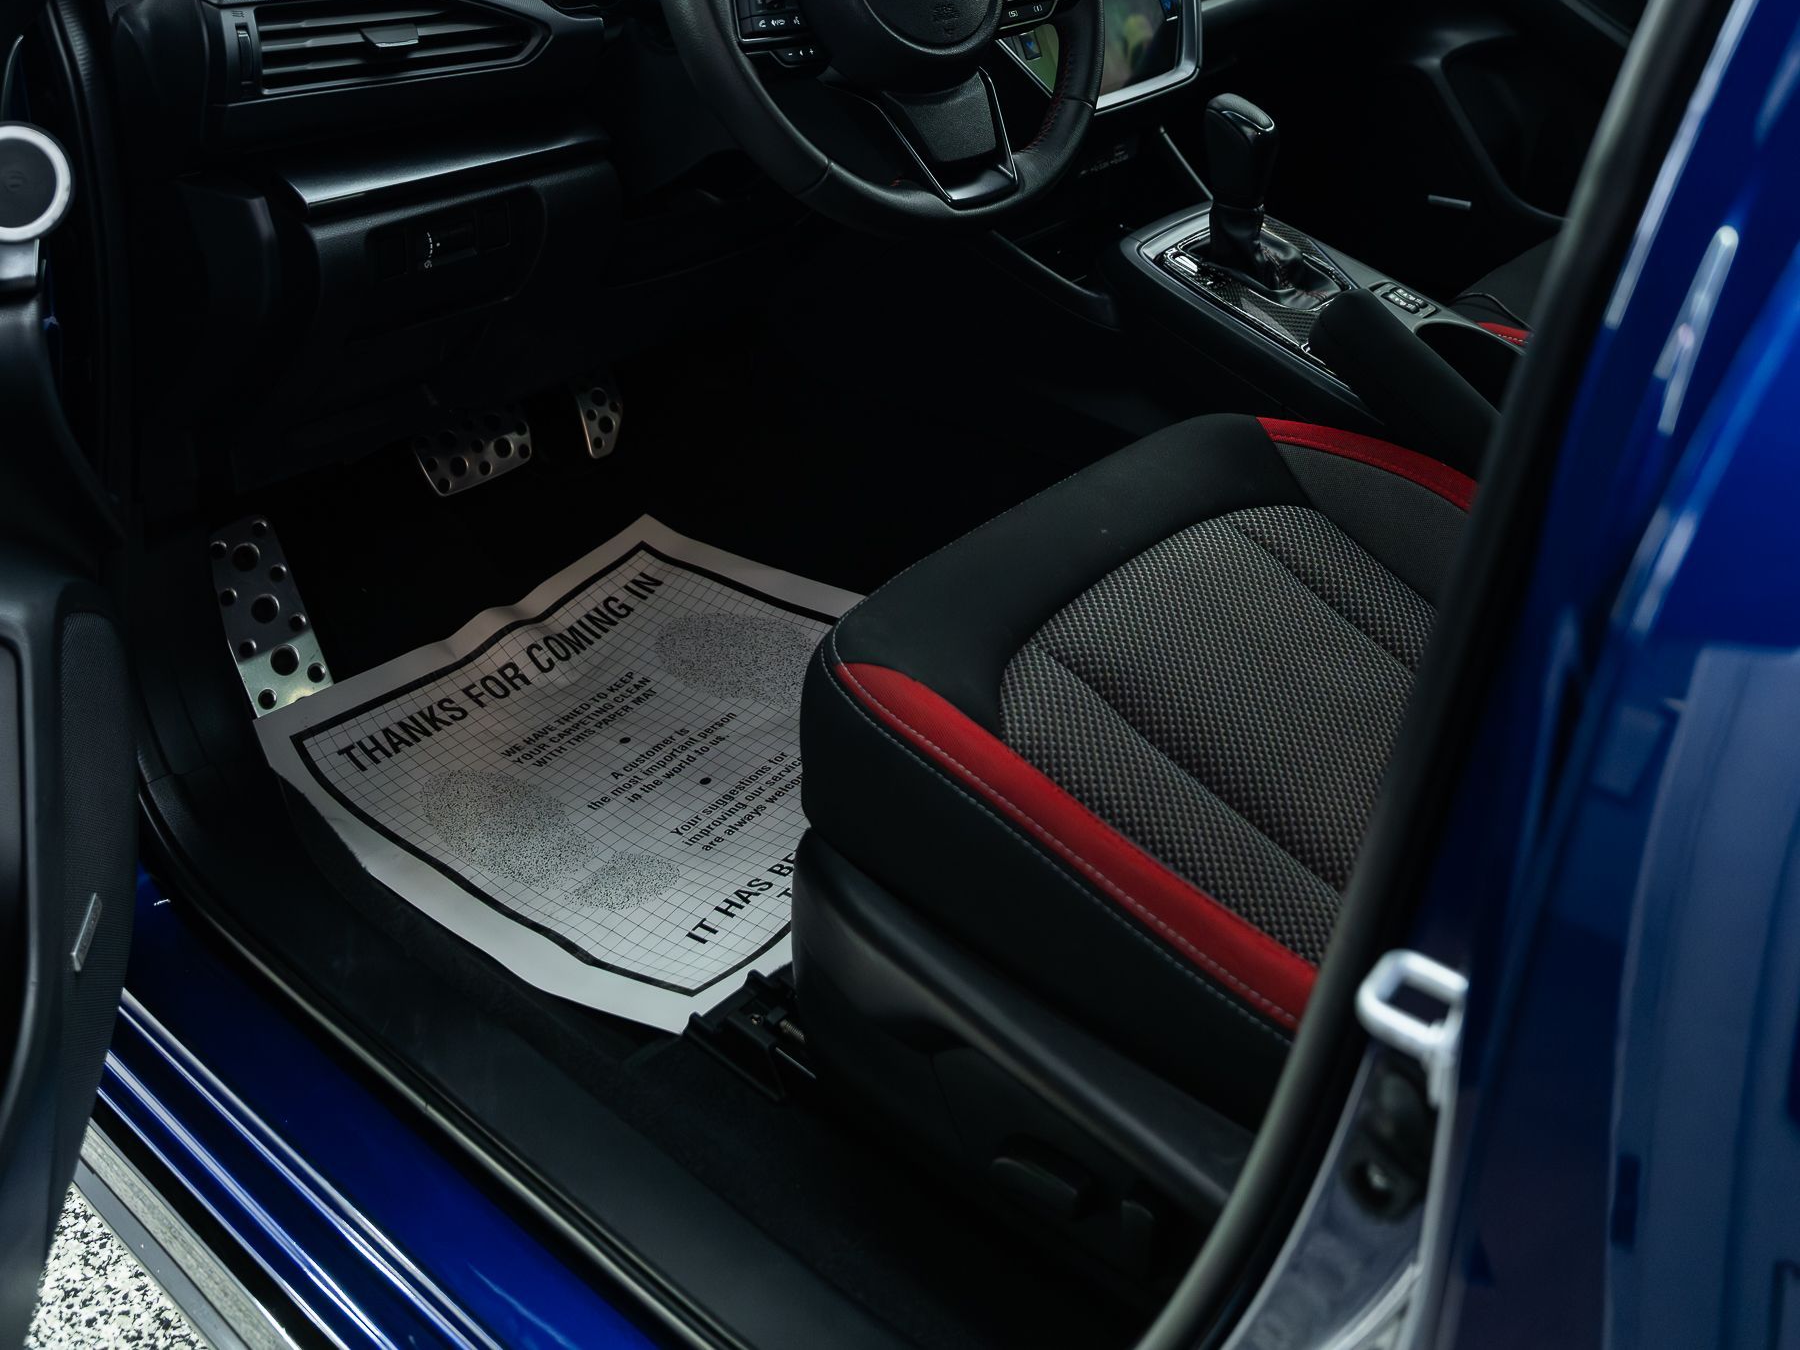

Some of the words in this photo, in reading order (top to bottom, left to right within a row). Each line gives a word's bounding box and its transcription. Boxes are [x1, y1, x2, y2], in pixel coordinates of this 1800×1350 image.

[337, 697, 469, 772] THANKS
[461, 661, 532, 708] FOR
[526, 595, 634, 674] COMING
[623, 571, 663, 602] IN
[501, 743, 524, 757] WE
[523, 725, 557, 745] HAVE
[554, 702, 591, 726] TRIED
[590, 691, 608, 704] TO
[606, 671, 635, 694] KEEP
[512, 743, 551, 765] YOUR
[550, 702, 615, 744] CARPETING
[613, 676, 651, 704] CLEAN
[532, 745, 568, 768] WITH
[566, 728, 596, 747] THIS
[594, 705, 634, 729] PAPER
[631, 687, 657, 706] MAT
[610, 770, 624, 780] A
[623, 734, 676, 773] customer
[674, 727, 690, 737] is
[587, 795, 611, 811] the
[610, 775, 643, 797] most
[642, 736, 698, 777] important
[697, 712, 737, 740] person
[625, 791, 642, 803] in
[640, 778, 663, 794] the
[662, 754, 697, 780] world
[694, 745, 710, 756] to
[709, 734, 730, 746] us.
[670, 814, 703, 837] Your
[701, 765, 771, 816] suggestions
[768, 751, 789, 765] for
[682, 800, 748, 847] improving
[745, 785, 766, 802] our
[701, 836, 725, 852] are
[724, 804, 767, 836] always
[685, 917, 719, 945] IT
[713, 877, 774, 918] HAS
